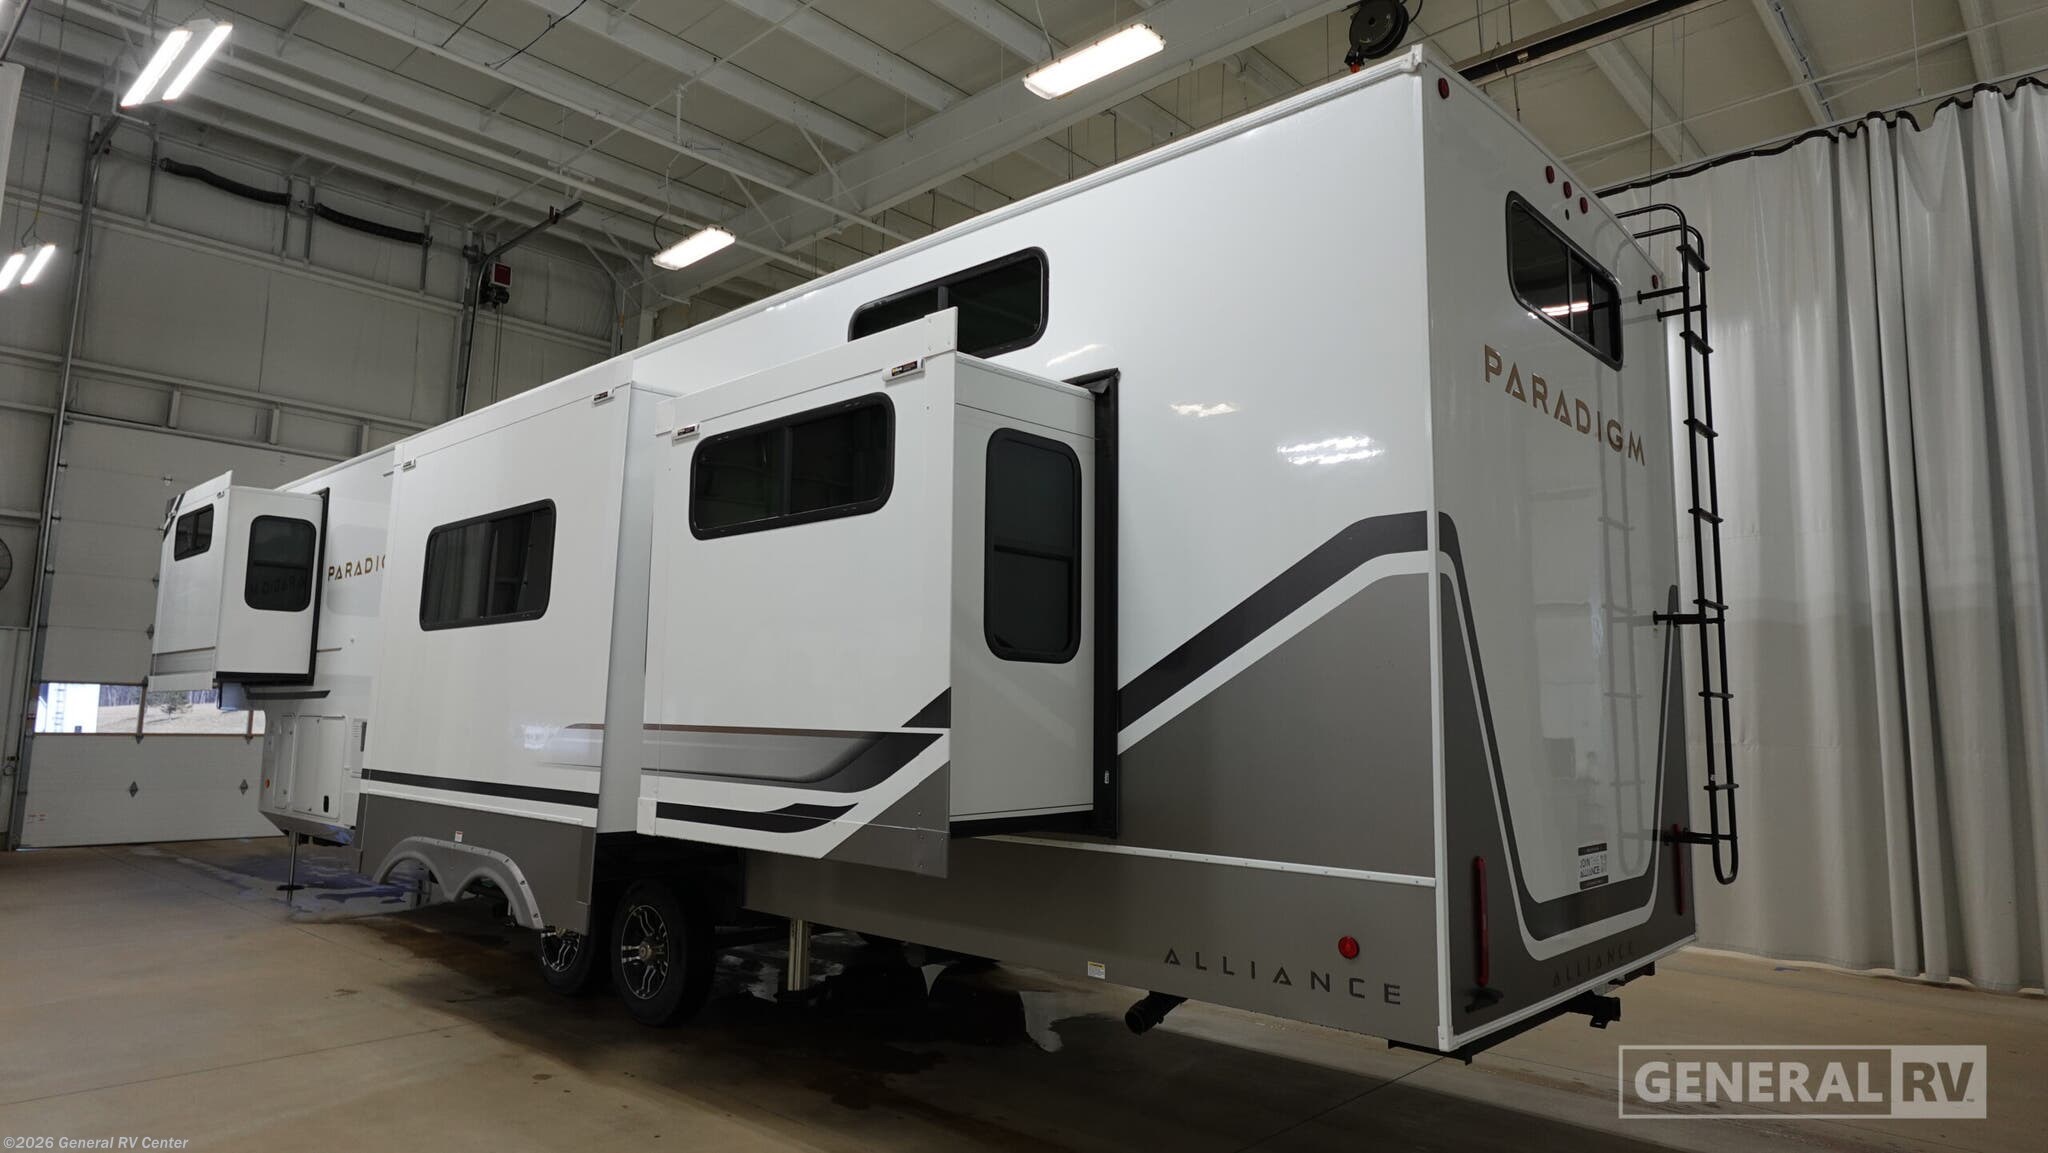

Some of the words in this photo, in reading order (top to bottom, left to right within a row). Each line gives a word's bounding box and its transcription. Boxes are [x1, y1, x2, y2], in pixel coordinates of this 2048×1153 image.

[1484, 343, 1646, 467] PARADIGM
[1163, 947, 1402, 1006] ALLIANCE
[1553, 941, 1635, 987] ALLIANCE
